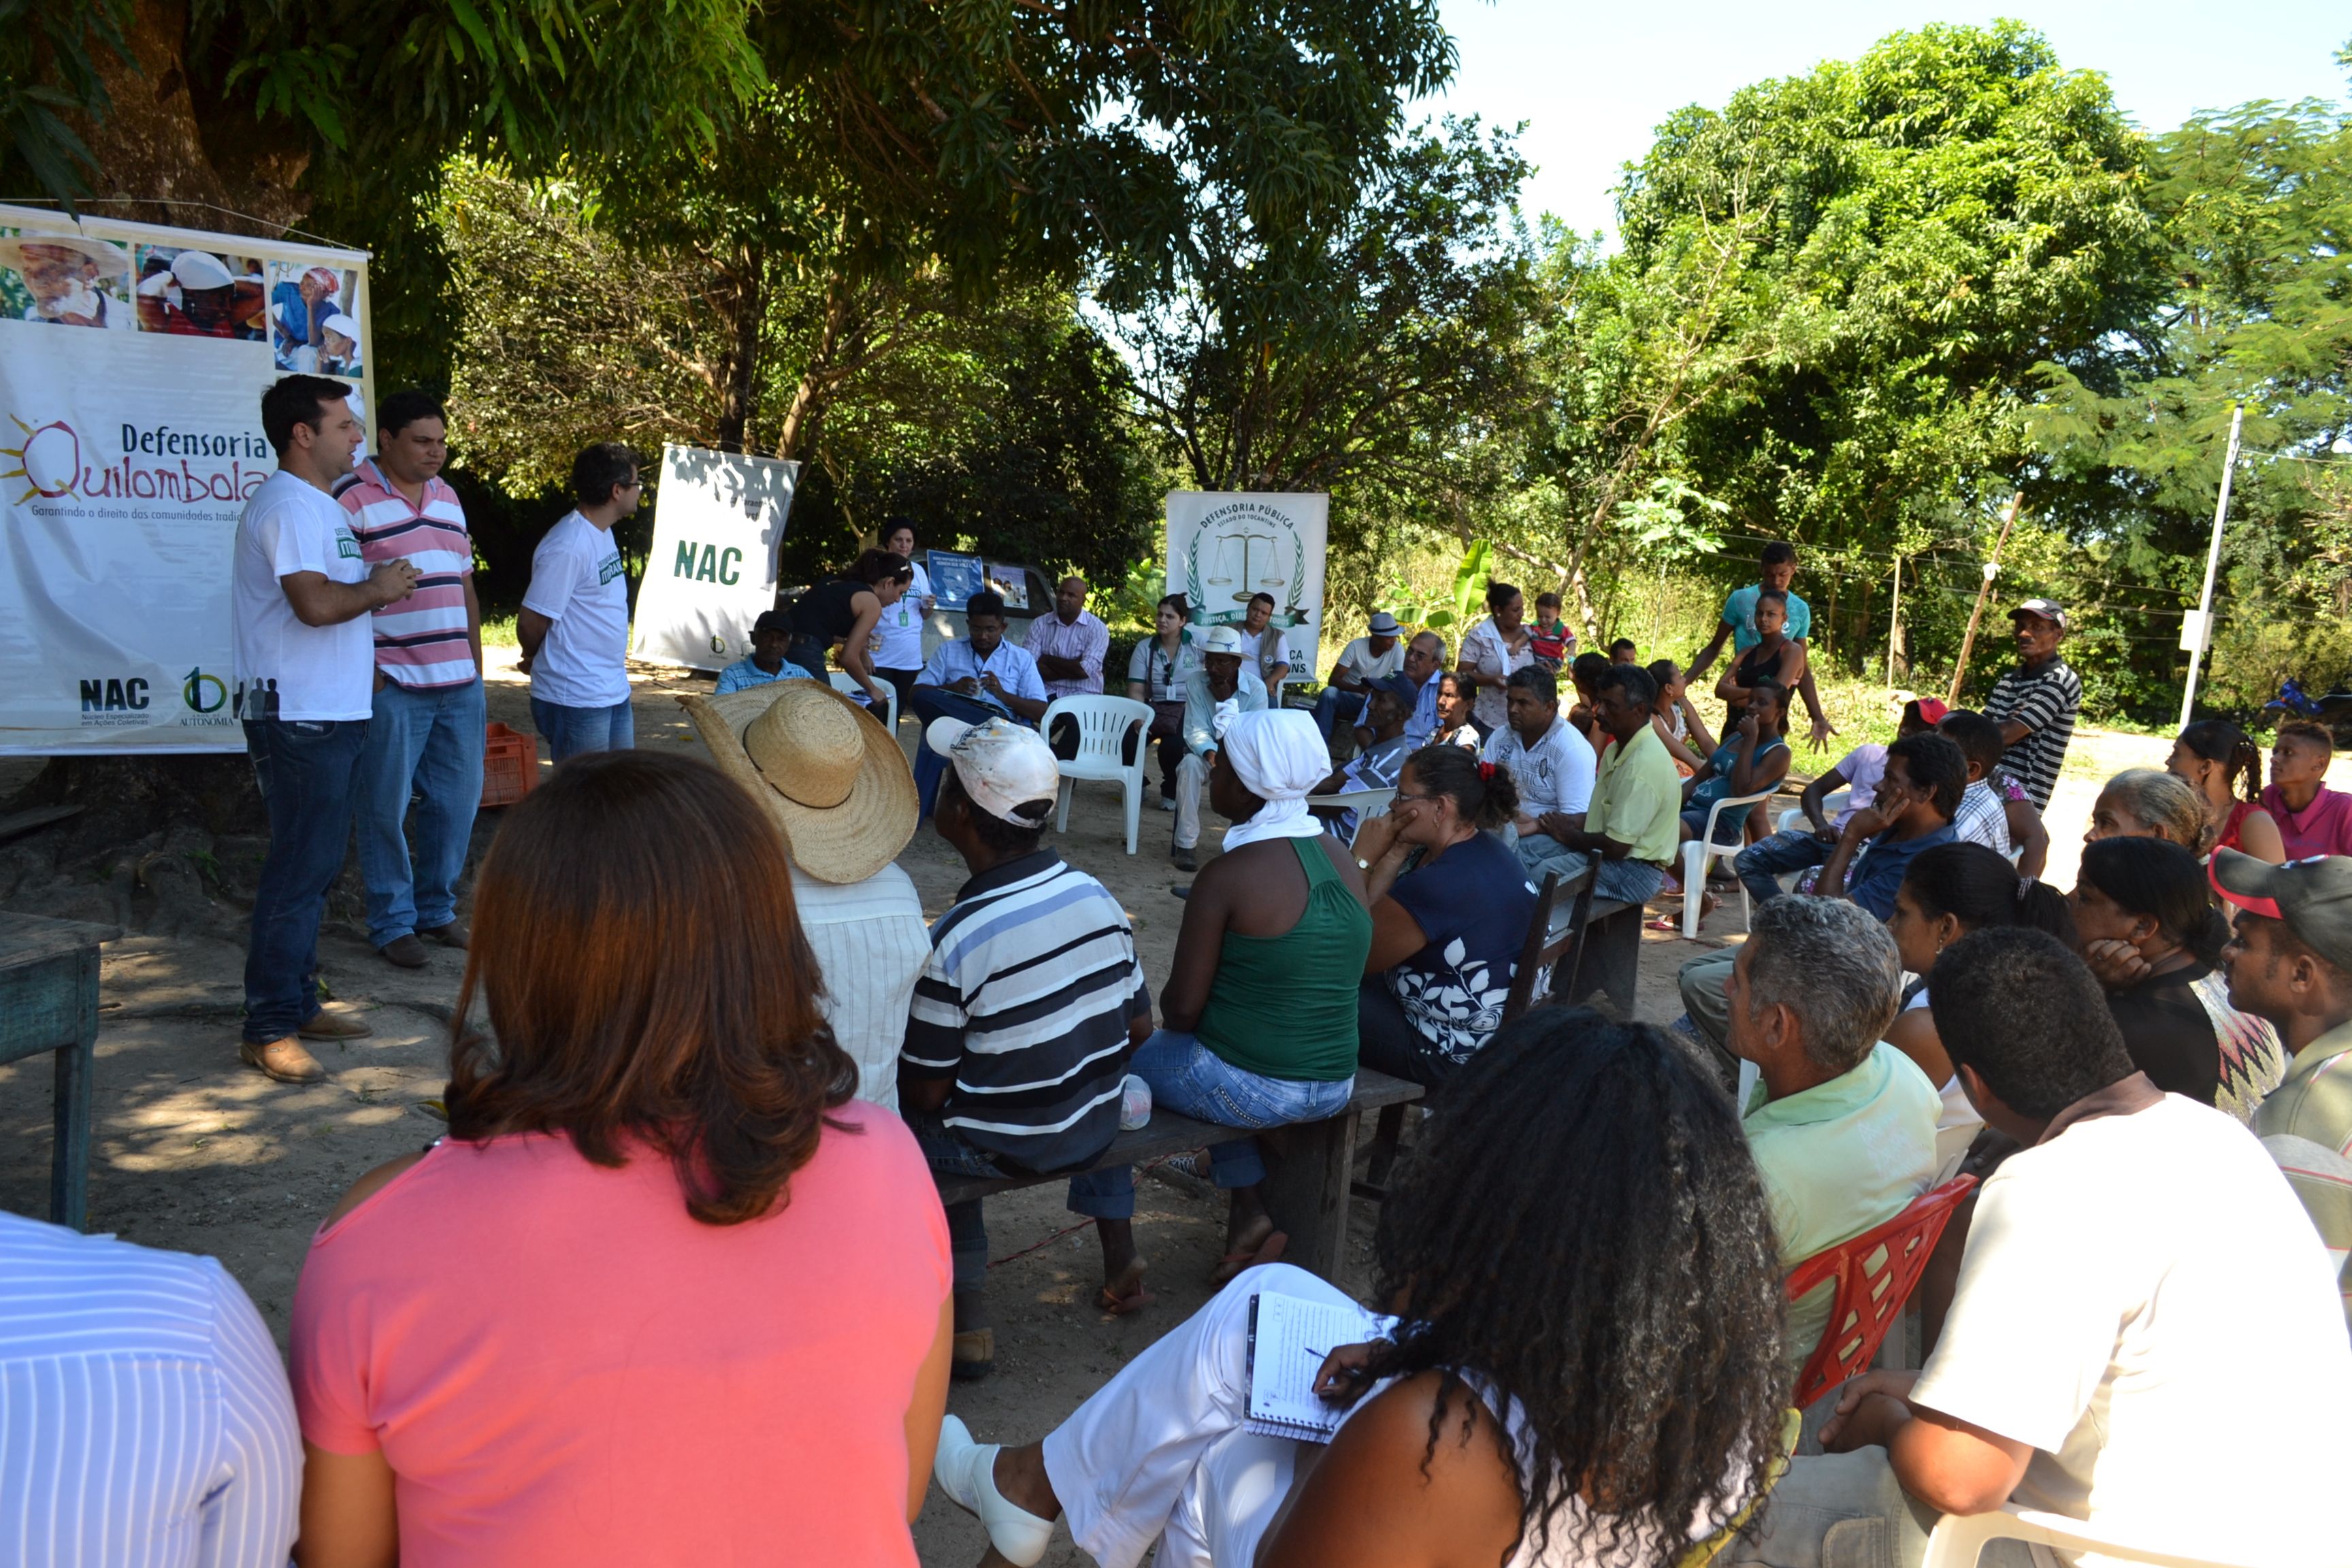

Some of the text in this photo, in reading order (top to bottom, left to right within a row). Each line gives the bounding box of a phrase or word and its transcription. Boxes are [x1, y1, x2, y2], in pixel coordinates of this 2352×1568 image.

[122, 423, 267, 459] Defensoria
[32, 505, 241, 522] Garantindo o direito das comunidades tradic
[1200, 503, 1294, 530] DEFENSORIA PÚBLICA
[1218, 515, 1237, 527] ESTADO
[1247, 514, 1276, 528] TOCANTINS
[674, 540, 742, 585] NAC
[1200, 612, 1289, 625] JUSTIÇA, DIRE TODOS
[1289, 650, 1303, 660] CA
[80, 678, 150, 711] NAC
[180, 717, 233, 727] AUTONOMIA
